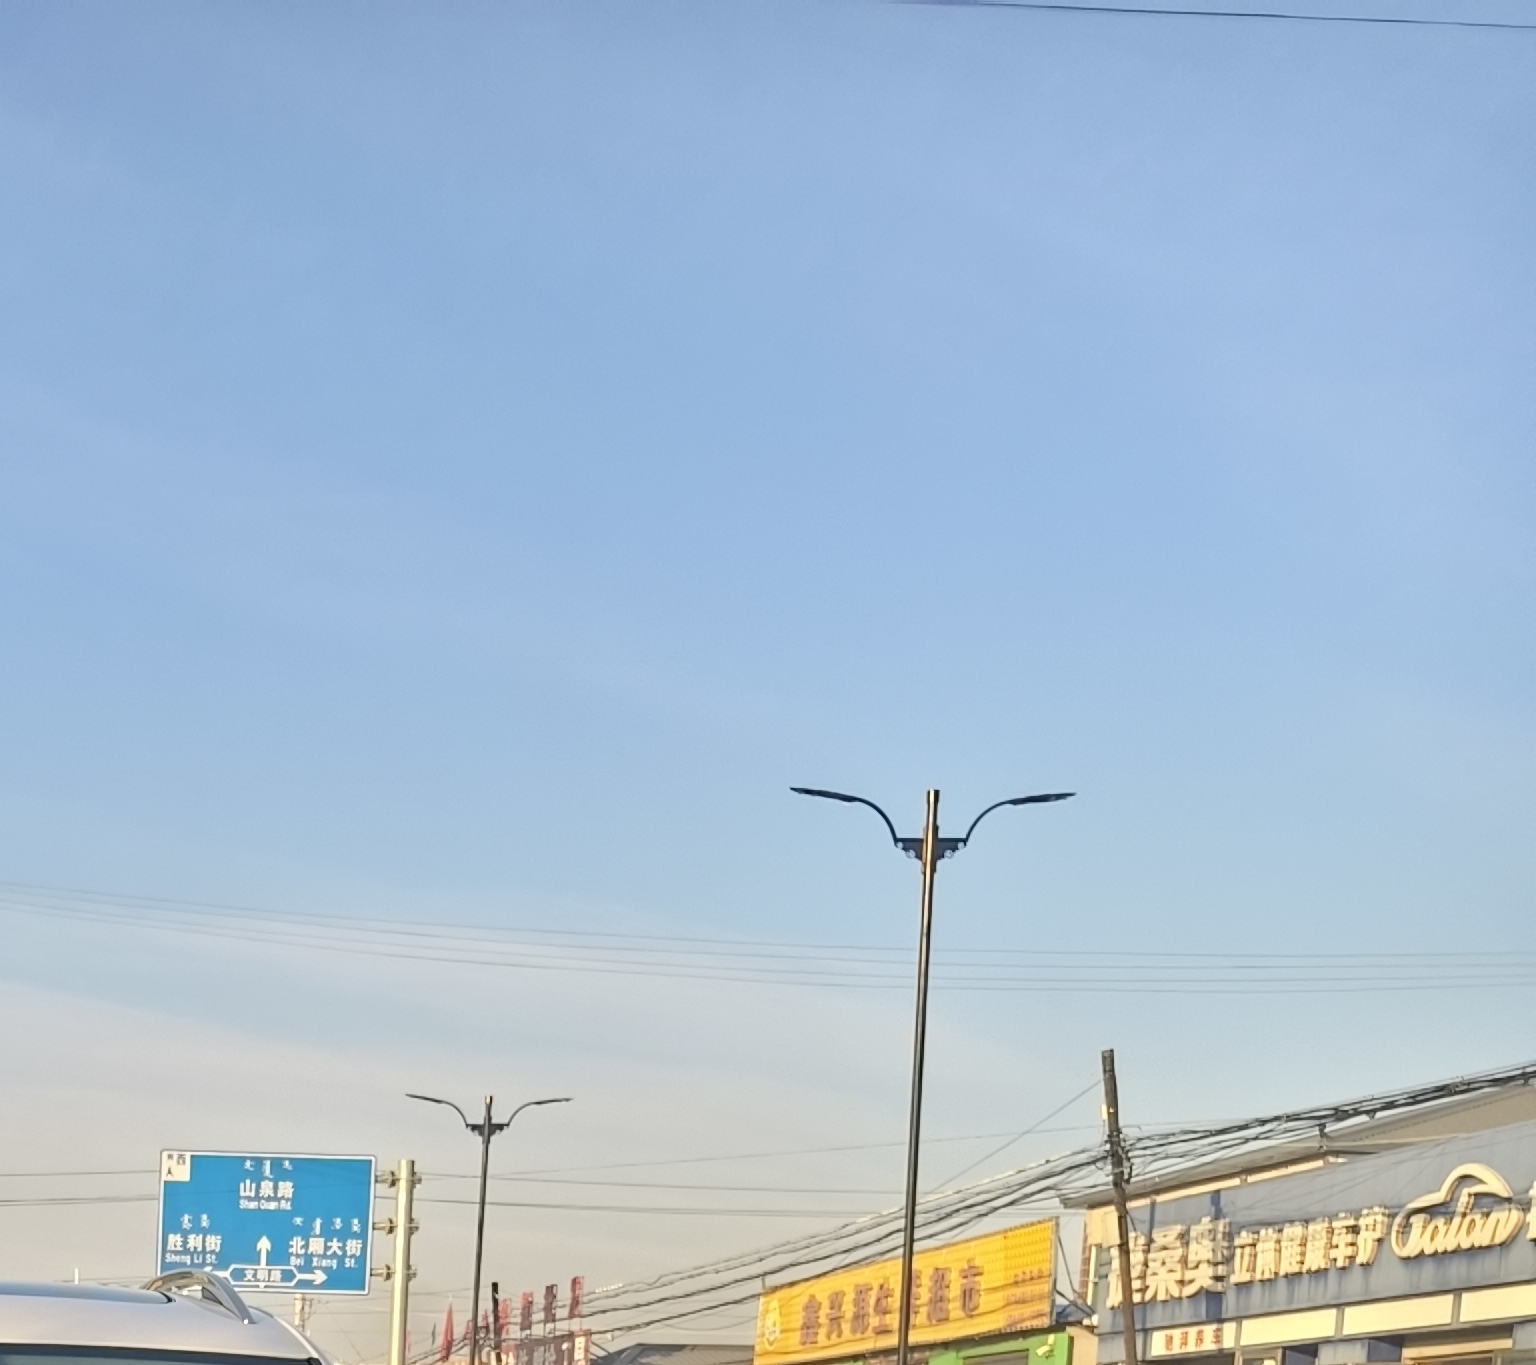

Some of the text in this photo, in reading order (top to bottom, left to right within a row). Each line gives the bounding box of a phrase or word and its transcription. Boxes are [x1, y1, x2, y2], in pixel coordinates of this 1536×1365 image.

[239, 1179, 294, 1199] 山泉路
[167, 1233, 222, 1253] 胜利街
[165, 1253, 191, 1265] Sheng
[312, 1257, 337, 1270] Xiang
